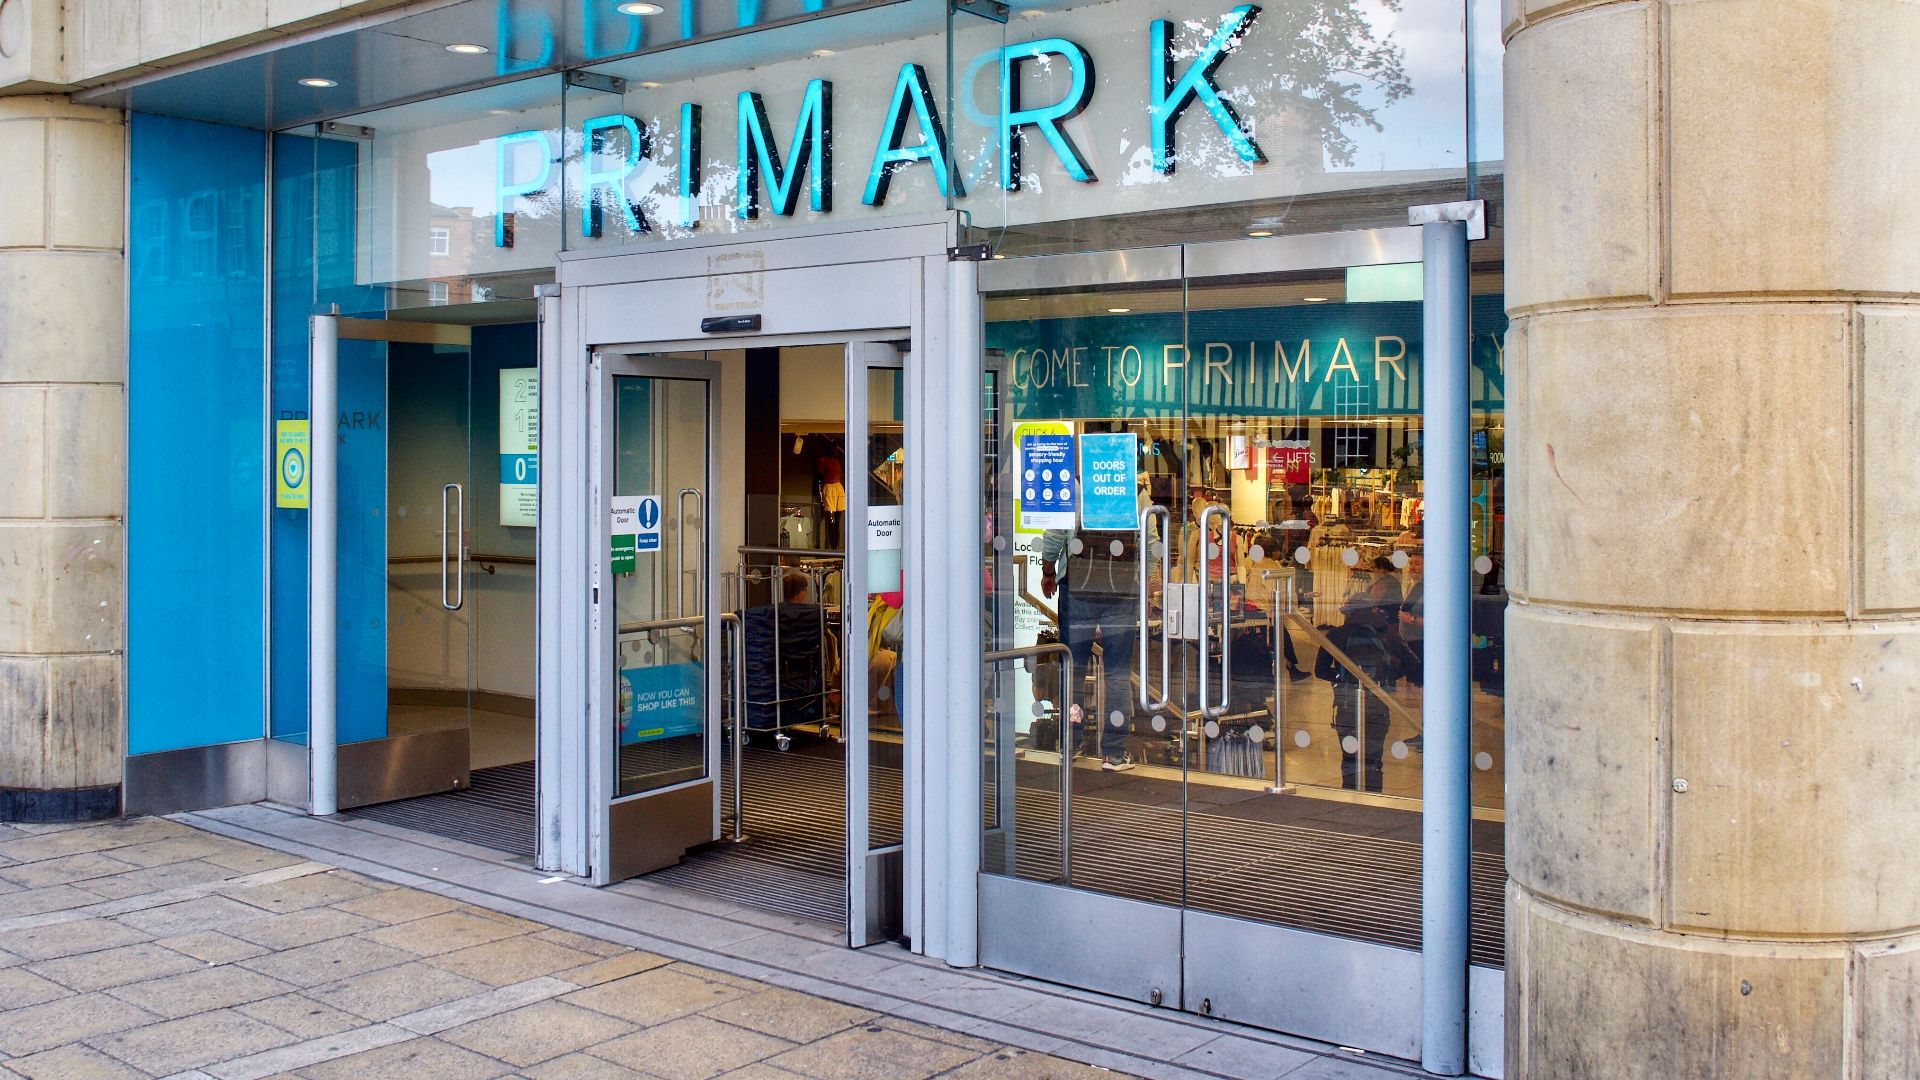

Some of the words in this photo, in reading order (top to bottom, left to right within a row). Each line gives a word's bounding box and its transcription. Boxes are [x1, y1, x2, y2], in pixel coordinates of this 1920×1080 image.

[495, 4, 1268, 247] PRIMARK
[1101, 346, 1142, 387] TO
[1163, 335, 1407, 386] PRIMAR
[515, 379, 527, 403] 2
[515, 409, 524, 433] 1
[1490, 453, 1504, 464] ROOM
[515, 458, 527, 481] 0
[1093, 462, 1126, 470] DOORS
[1093, 475, 1112, 483] OUT
[1114, 475, 1126, 483] OF
[1094, 487, 1126, 496] ORDER
[868, 519, 901, 527] Automatic
[1015, 542, 1032, 552] Loc
[1030, 557, 1043, 566] Flo
[638, 692, 657, 702] NOW
[658, 691, 673, 699] YOU
[675, 689, 690, 697] CAN
[638, 702, 660, 712] SHOP
[662, 700, 677, 709] LIKE
[679, 698, 696, 706] THIS
